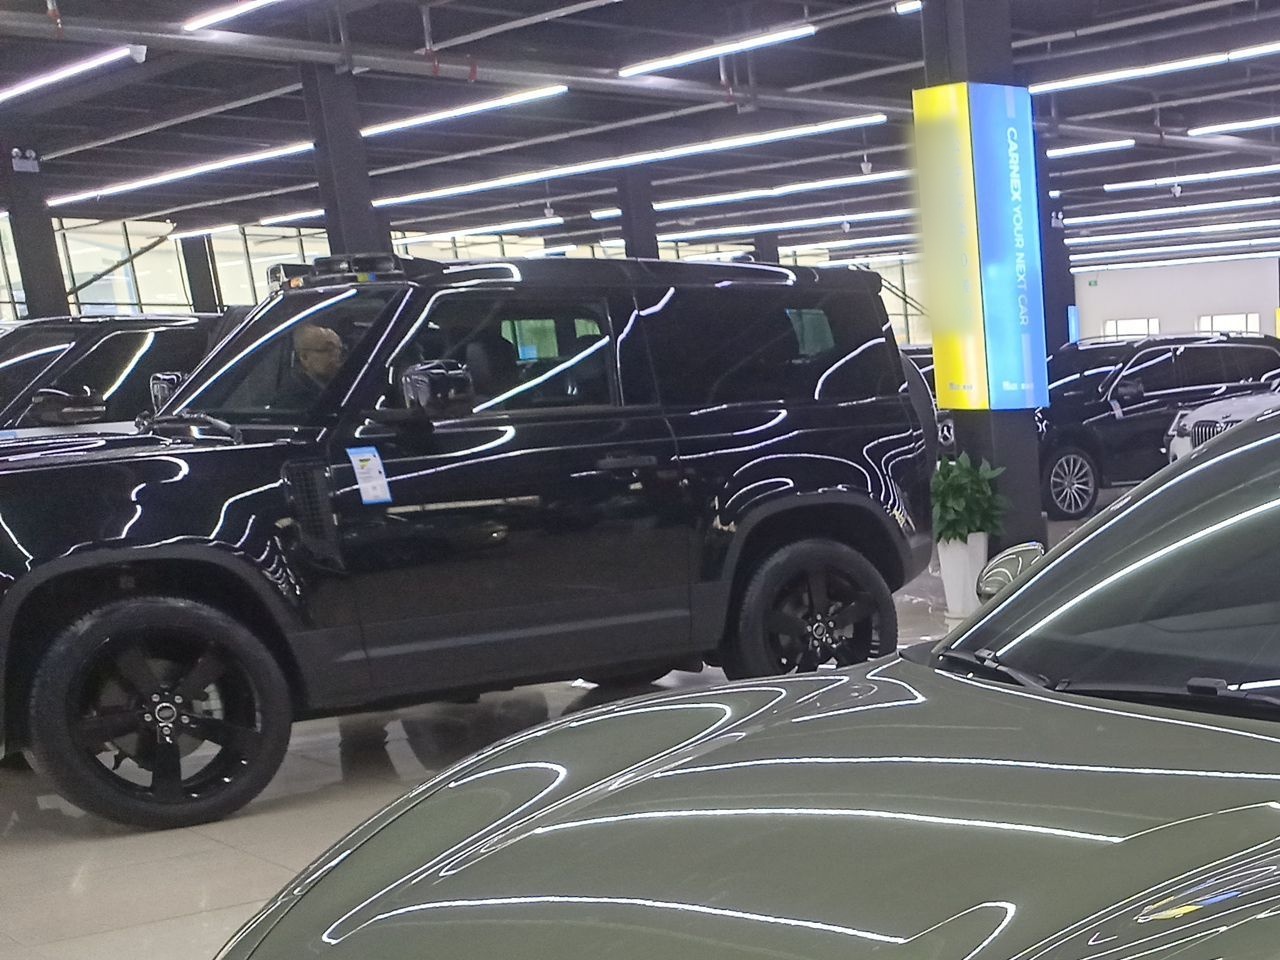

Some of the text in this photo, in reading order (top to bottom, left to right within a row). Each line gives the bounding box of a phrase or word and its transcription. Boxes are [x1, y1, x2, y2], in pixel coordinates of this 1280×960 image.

[1007, 127, 1029, 326] CARNEX YOUR NEXT CAR
